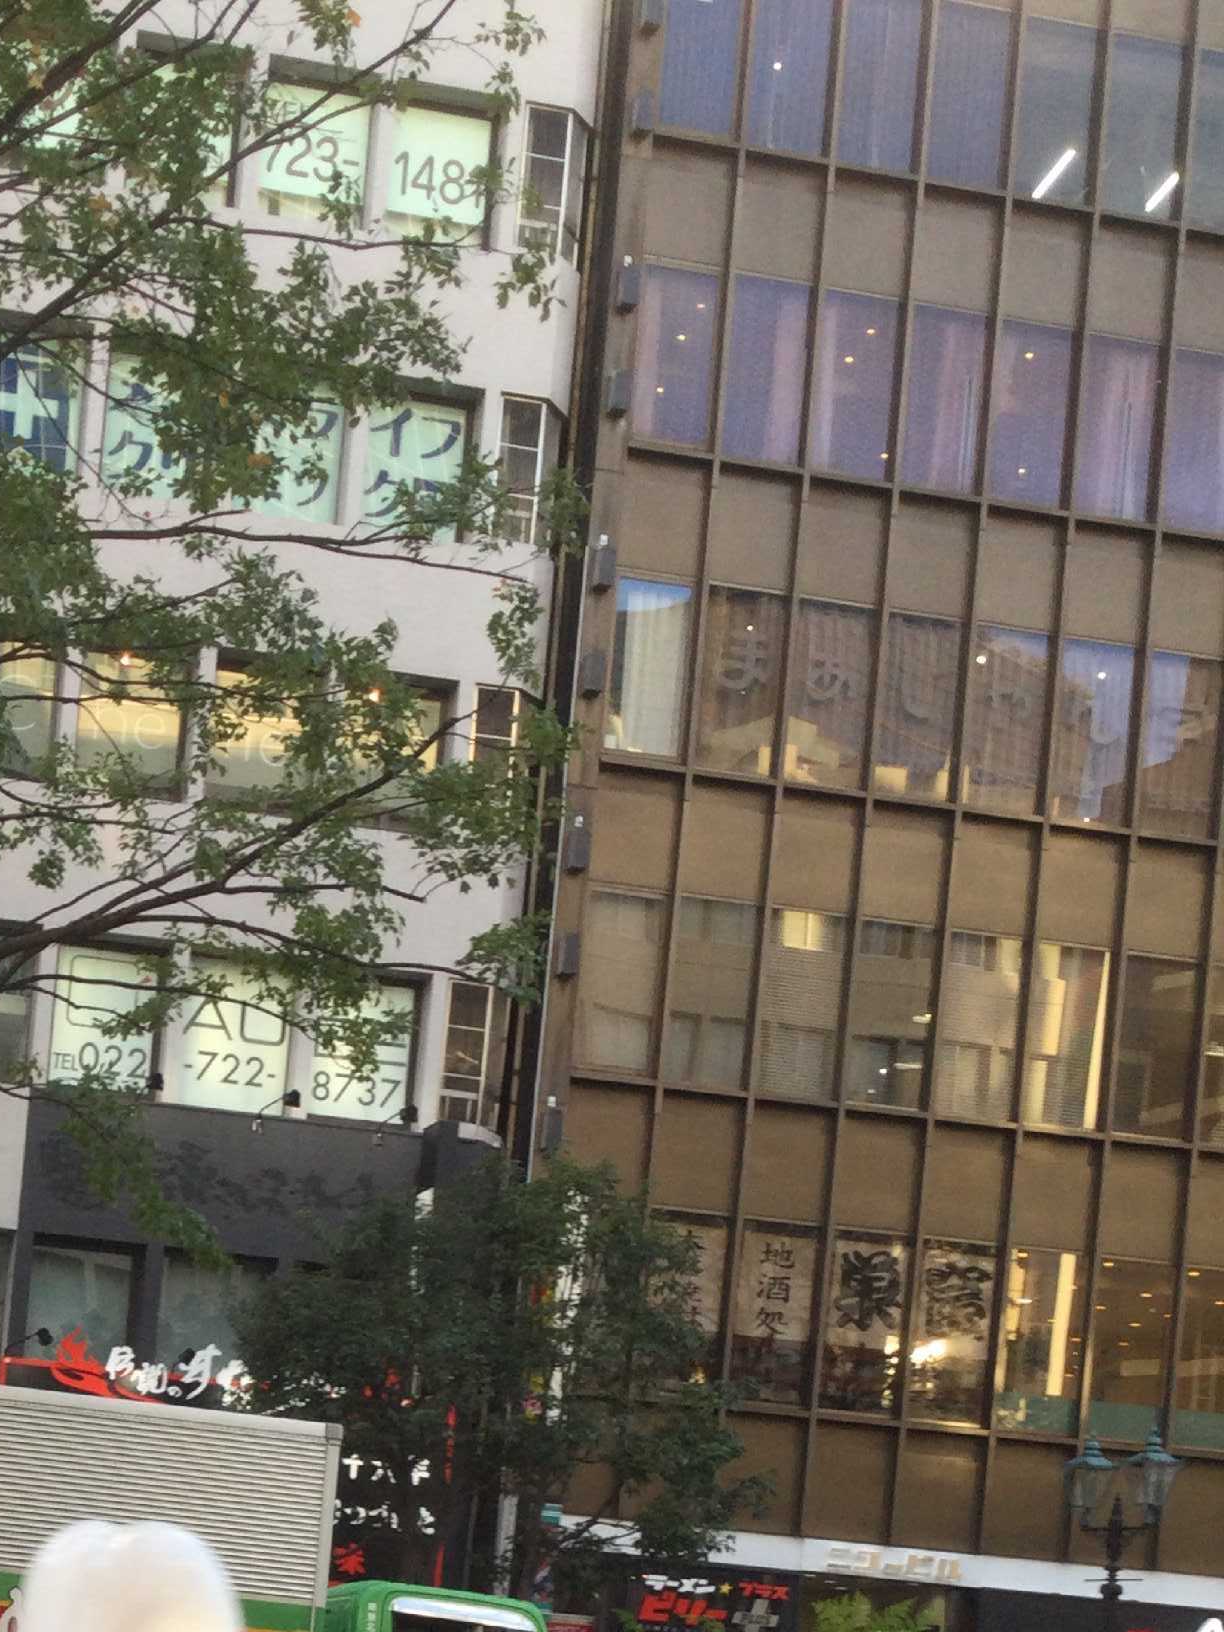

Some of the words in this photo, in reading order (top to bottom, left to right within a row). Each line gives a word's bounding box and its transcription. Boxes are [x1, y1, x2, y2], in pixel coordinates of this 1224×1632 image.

[312, 1070, 401, 1108] 8737
[755, 1241, 796, 1336] 地酒処
[641, 1574, 716, 1595] ラーメン
